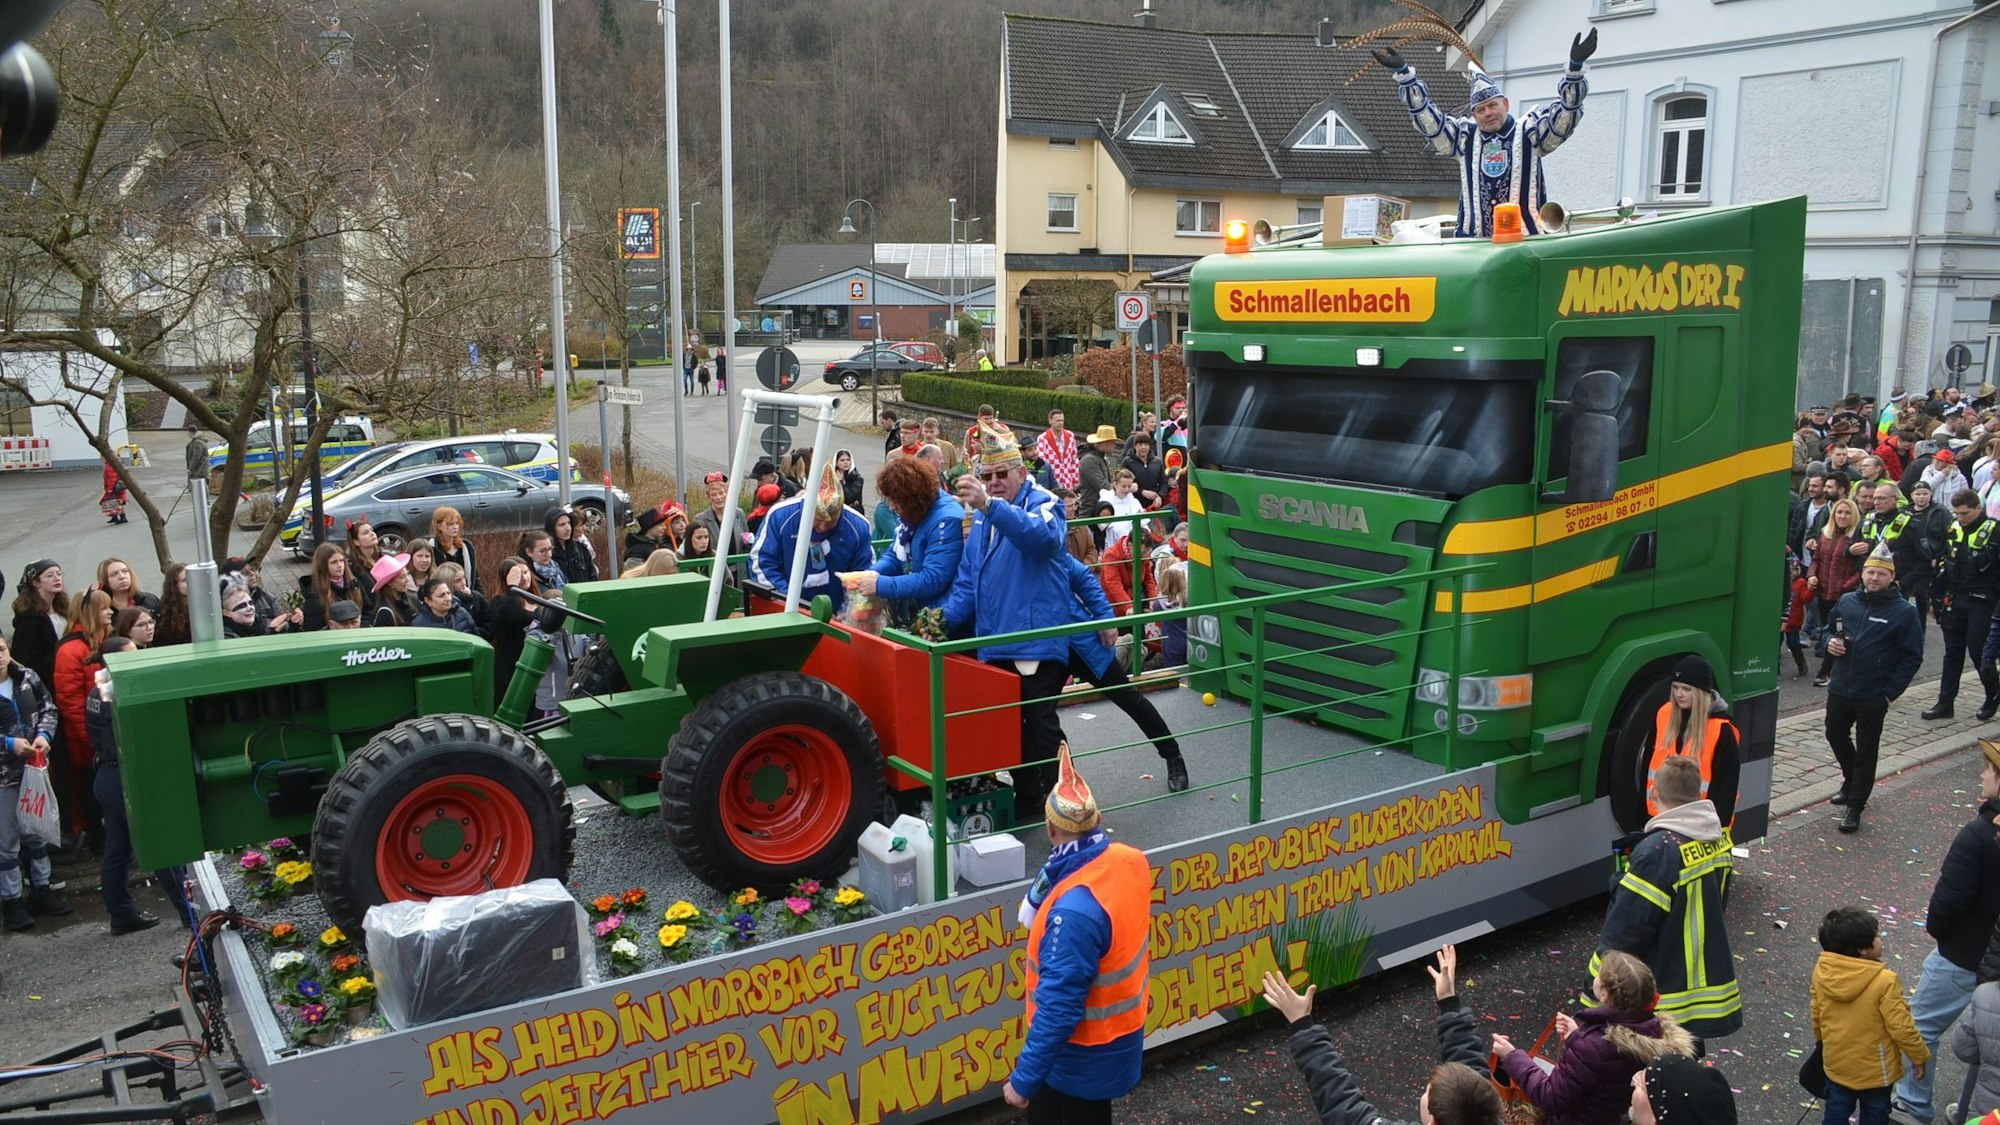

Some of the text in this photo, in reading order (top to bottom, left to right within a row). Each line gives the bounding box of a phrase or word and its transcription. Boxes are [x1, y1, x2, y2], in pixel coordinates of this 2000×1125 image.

[1229, 285, 1411, 314] Schmallenbach
[1557, 260, 1679, 318] MARKUS
[1679, 262, 1723, 308] DER
[1127, 303, 1139, 314] 30
[1631, 482, 1655, 498] GmbH
[1258, 493, 1370, 535] SCANIA
[1578, 511, 1609, 530] 02294
[341, 646, 412, 667] Holder
[423, 1026, 510, 1098] ALS
[509, 1008, 619, 1077] HELD
[668, 943, 860, 1033] MORSBACH
[860, 905, 1013, 983] GEBOREN,
[1169, 851, 1222, 896] DER
[1344, 784, 1483, 853] AUSERKOREN
[520, 1057, 650, 1125] JETZT
[757, 1007, 848, 1070] VOR
[855, 974, 962, 1048] EUCH
[954, 962, 1005, 1016] ZU
[1289, 856, 1373, 919] TRAUM
[1372, 845, 1416, 896] VON
[1418, 819, 1513, 880] KARNEVAL
[858, 1012, 1029, 1125] MUESCH
